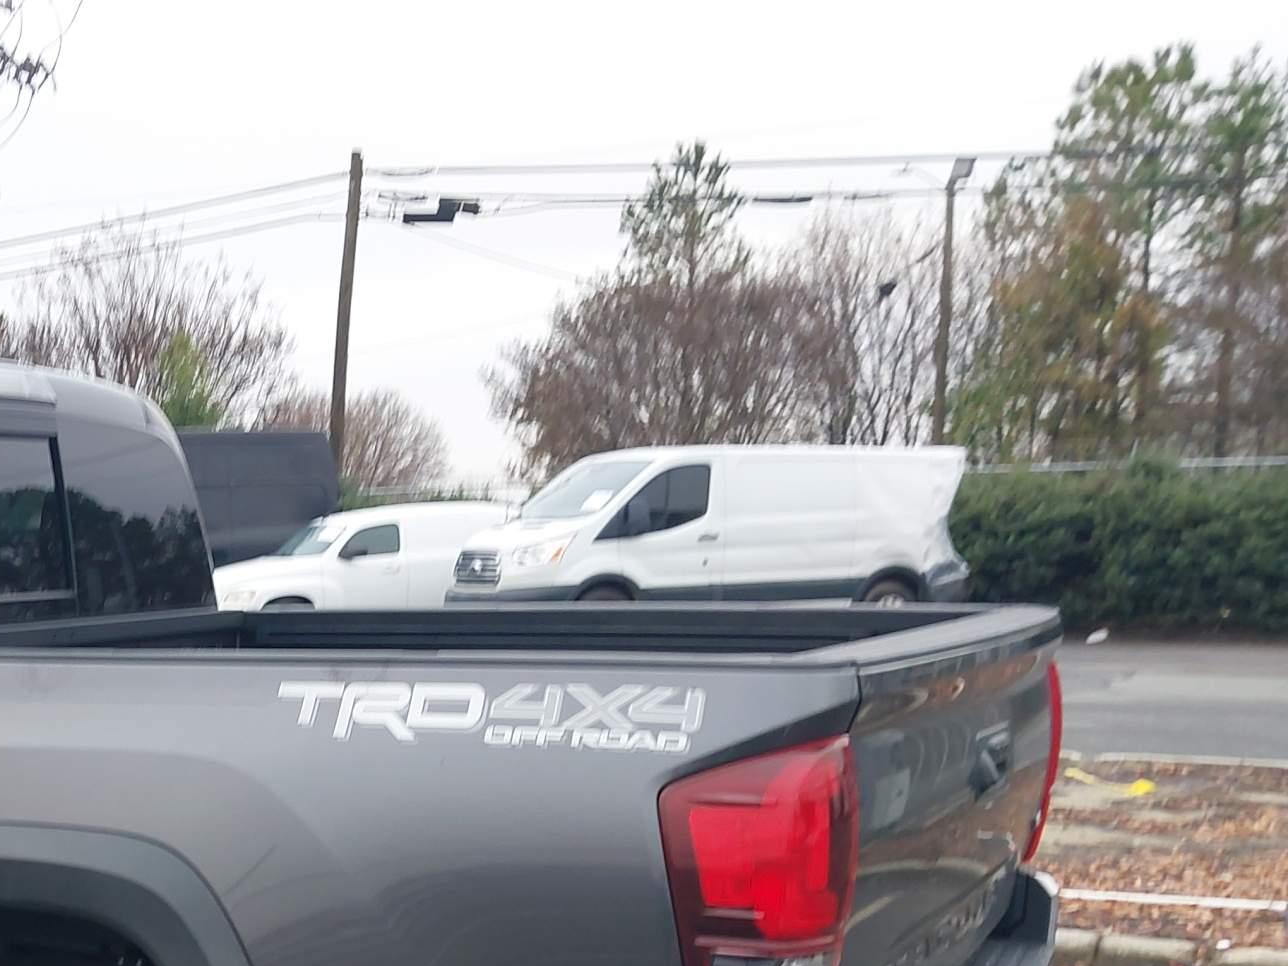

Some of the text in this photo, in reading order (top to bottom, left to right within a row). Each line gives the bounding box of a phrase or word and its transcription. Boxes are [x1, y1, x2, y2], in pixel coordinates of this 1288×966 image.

[278, 680, 706, 743] TRD 4X4
[484, 725, 691, 753] OFF ROAD
